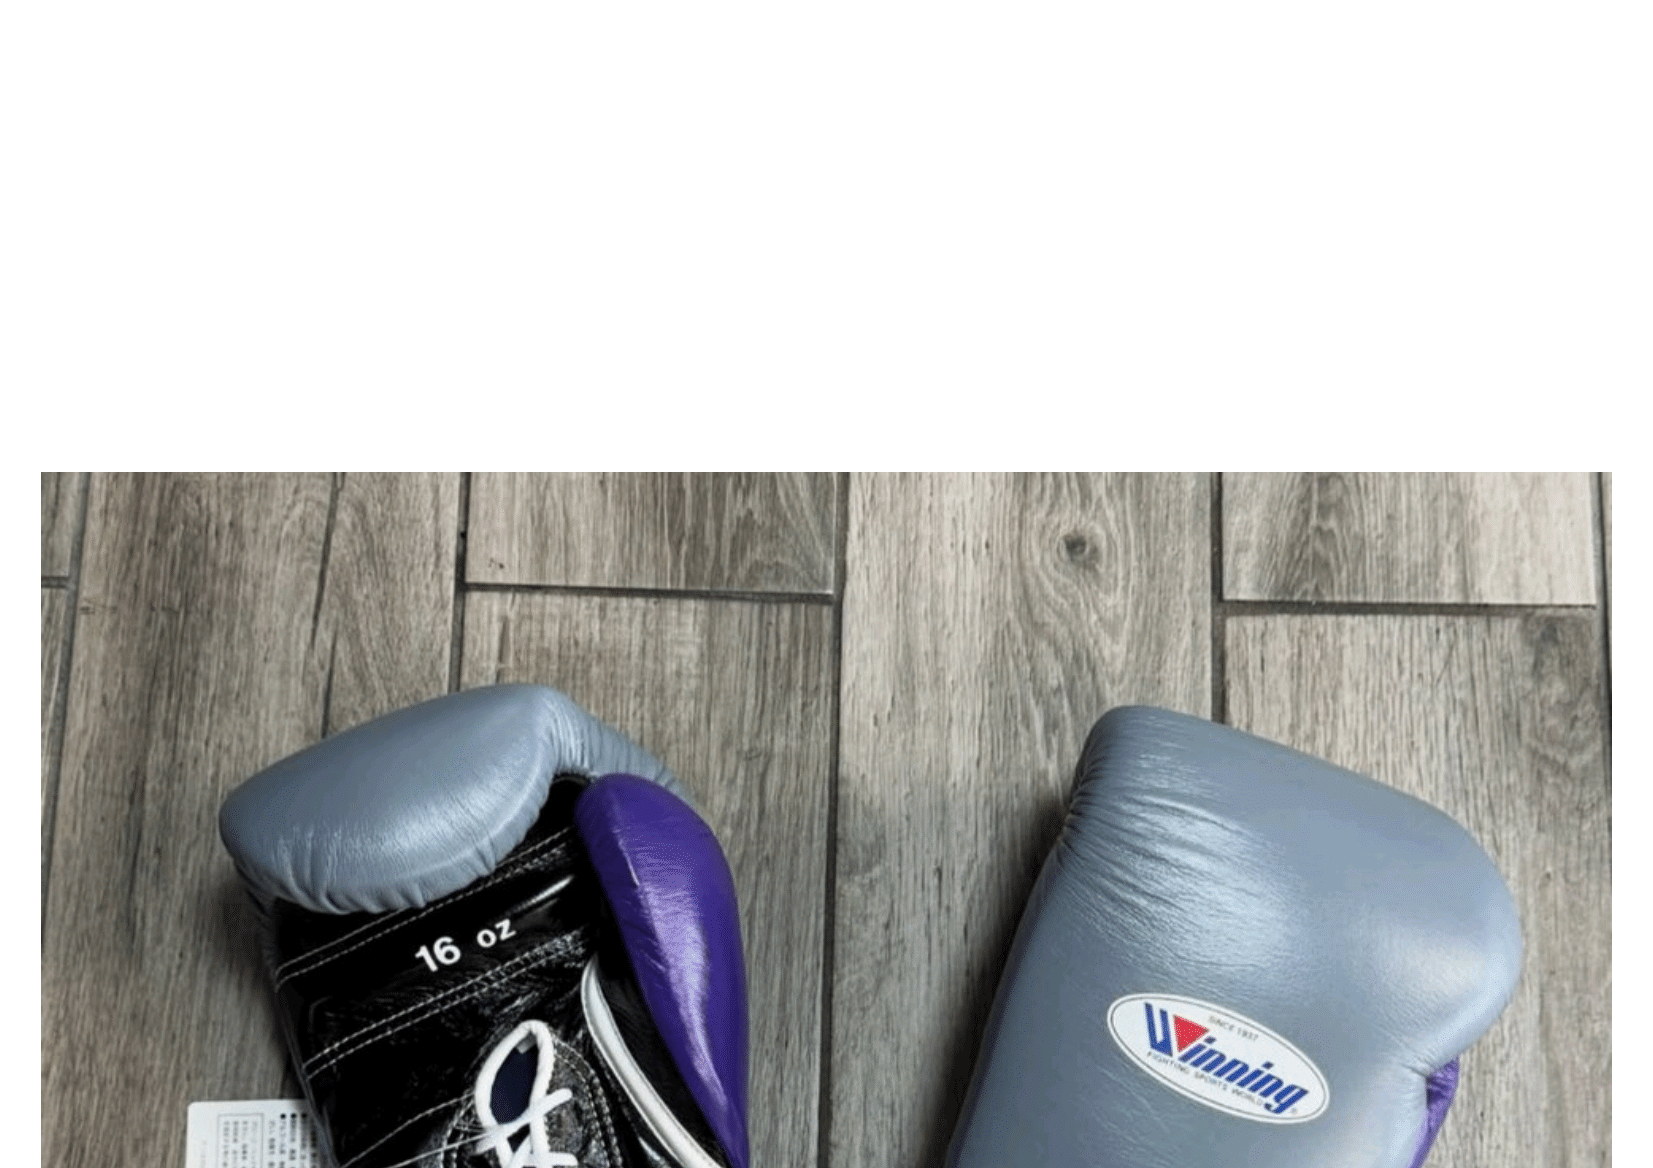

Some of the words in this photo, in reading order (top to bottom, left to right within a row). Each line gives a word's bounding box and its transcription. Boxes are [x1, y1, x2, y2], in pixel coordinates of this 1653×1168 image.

[415, 936, 461, 972] 16
[477, 919, 516, 948] oz
[1208, 1015, 1235, 1031] SINCE
[1145, 1002, 1309, 1114] Winning
[1147, 1051, 1190, 1075] FIGHTING
[1194, 1072, 1228, 1092] SPORTS
